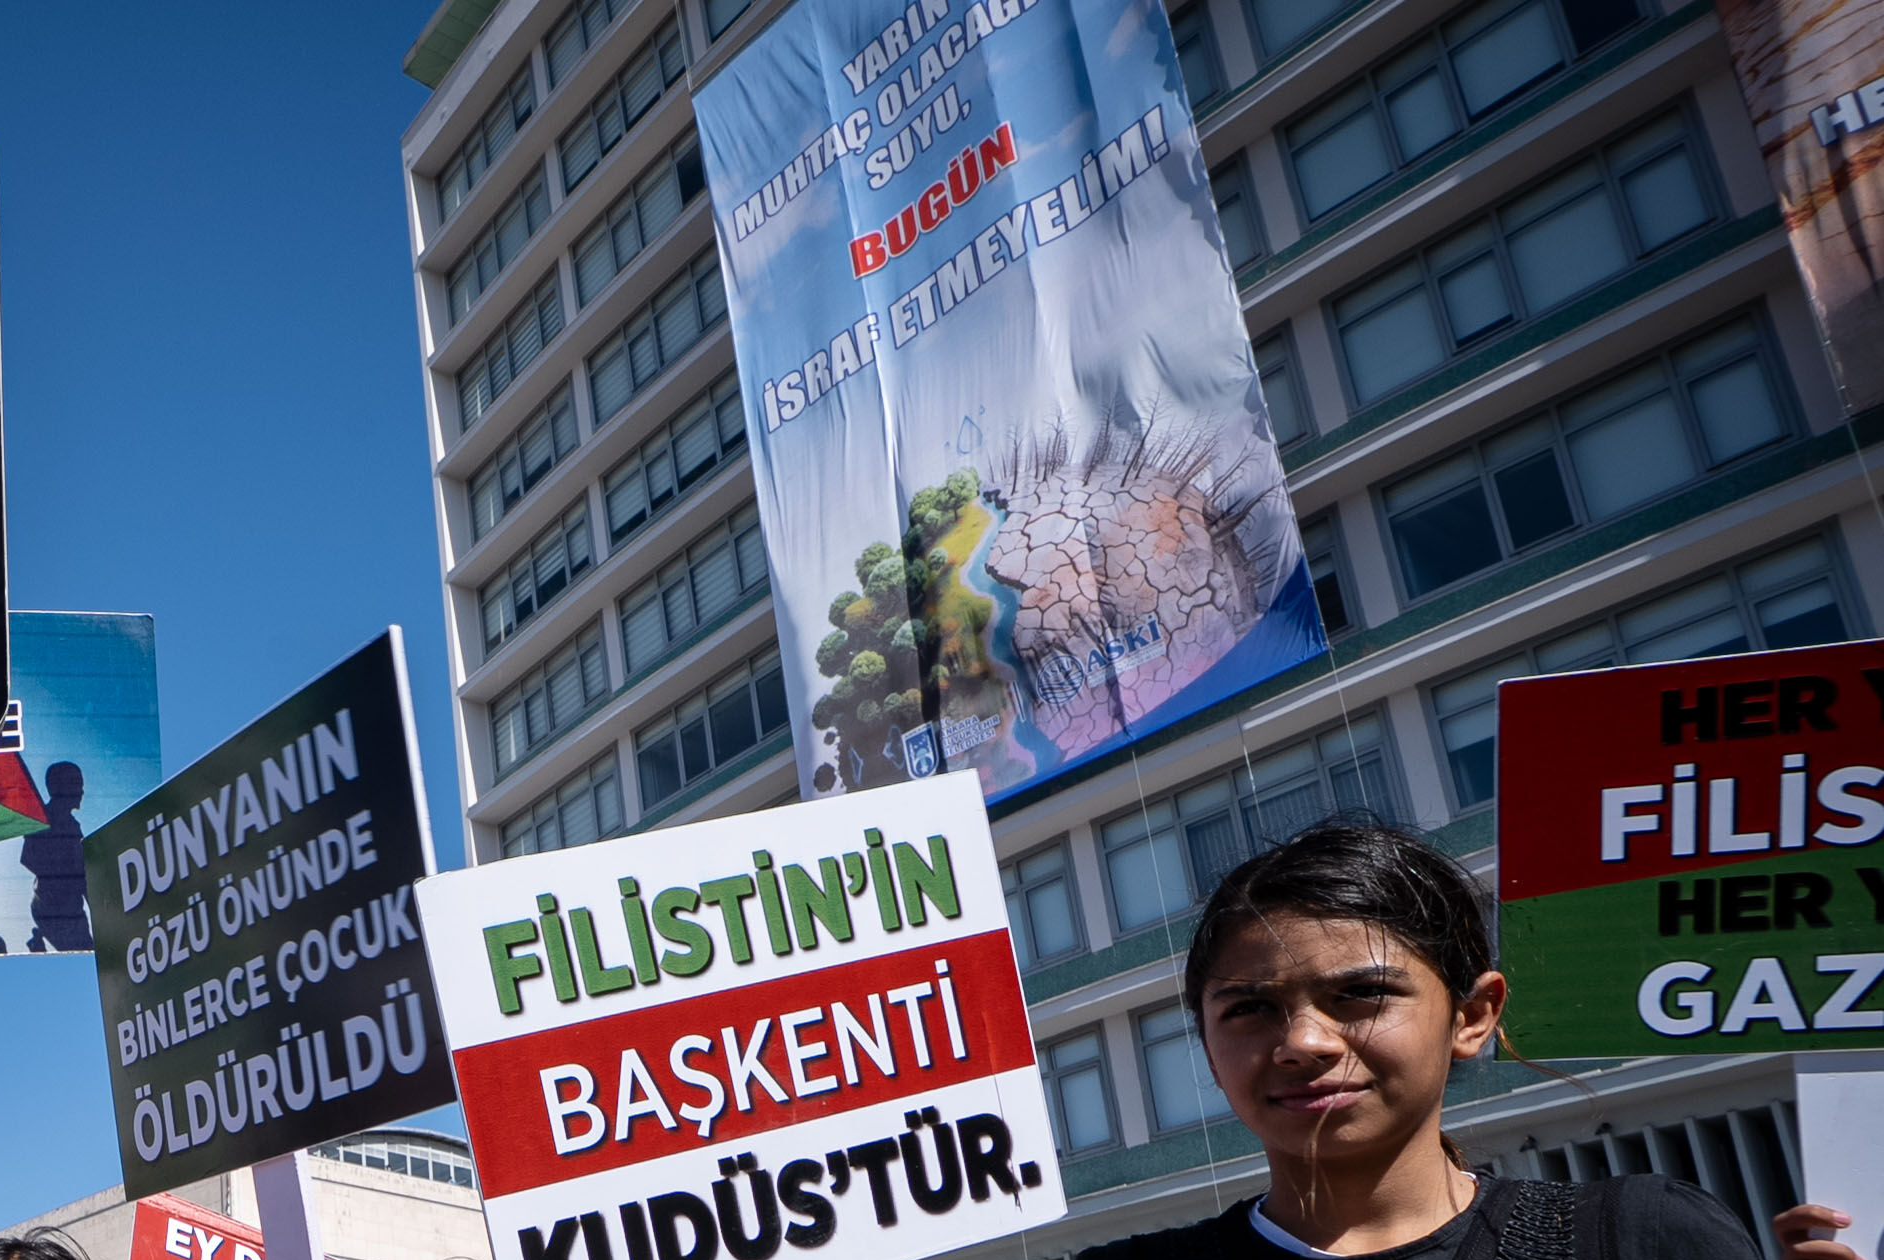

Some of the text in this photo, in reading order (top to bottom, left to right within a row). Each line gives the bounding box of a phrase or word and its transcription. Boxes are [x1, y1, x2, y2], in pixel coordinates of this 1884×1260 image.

[734, 108, 872, 241] MUHTAÇ
[848, 120, 1019, 280] BUGÜN
[866, 82, 972, 191] SUYU,
[762, 104, 1170, 433] İSRAF ETMEYELİM!
[1661, 675, 1839, 746] HER
[117, 708, 361, 912] DÜNYANIN
[125, 809, 379, 984] GÖZÜ ÖNÜNDE
[117, 883, 420, 1066] BİNLERCE ÇOCUK
[1658, 872, 1834, 936] HER
[133, 978, 428, 1163] ÖLDÜRÜLDÜ
[539, 958, 968, 1156] BAŞKENTİ
